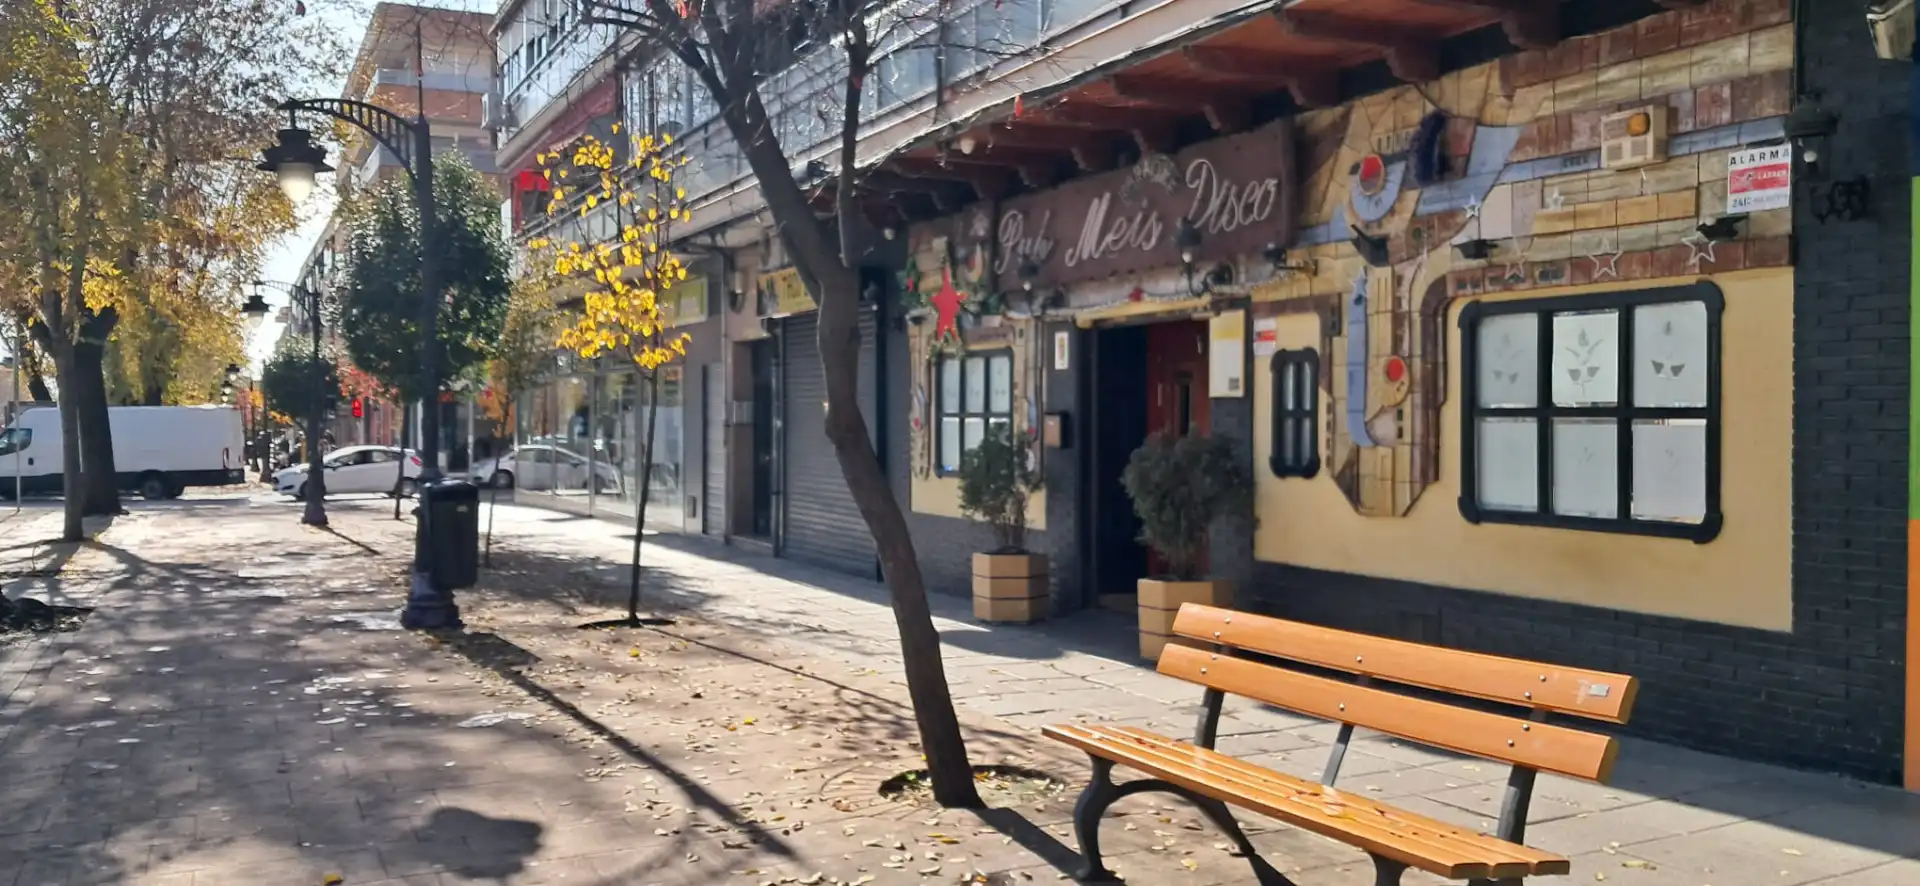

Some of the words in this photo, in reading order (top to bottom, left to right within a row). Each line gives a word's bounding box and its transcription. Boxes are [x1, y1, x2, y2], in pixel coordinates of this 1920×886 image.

[1730, 148, 1789, 165] ALARMA
[1065, 191, 1163, 268] Meis
[1186, 159, 1278, 234] Disco
